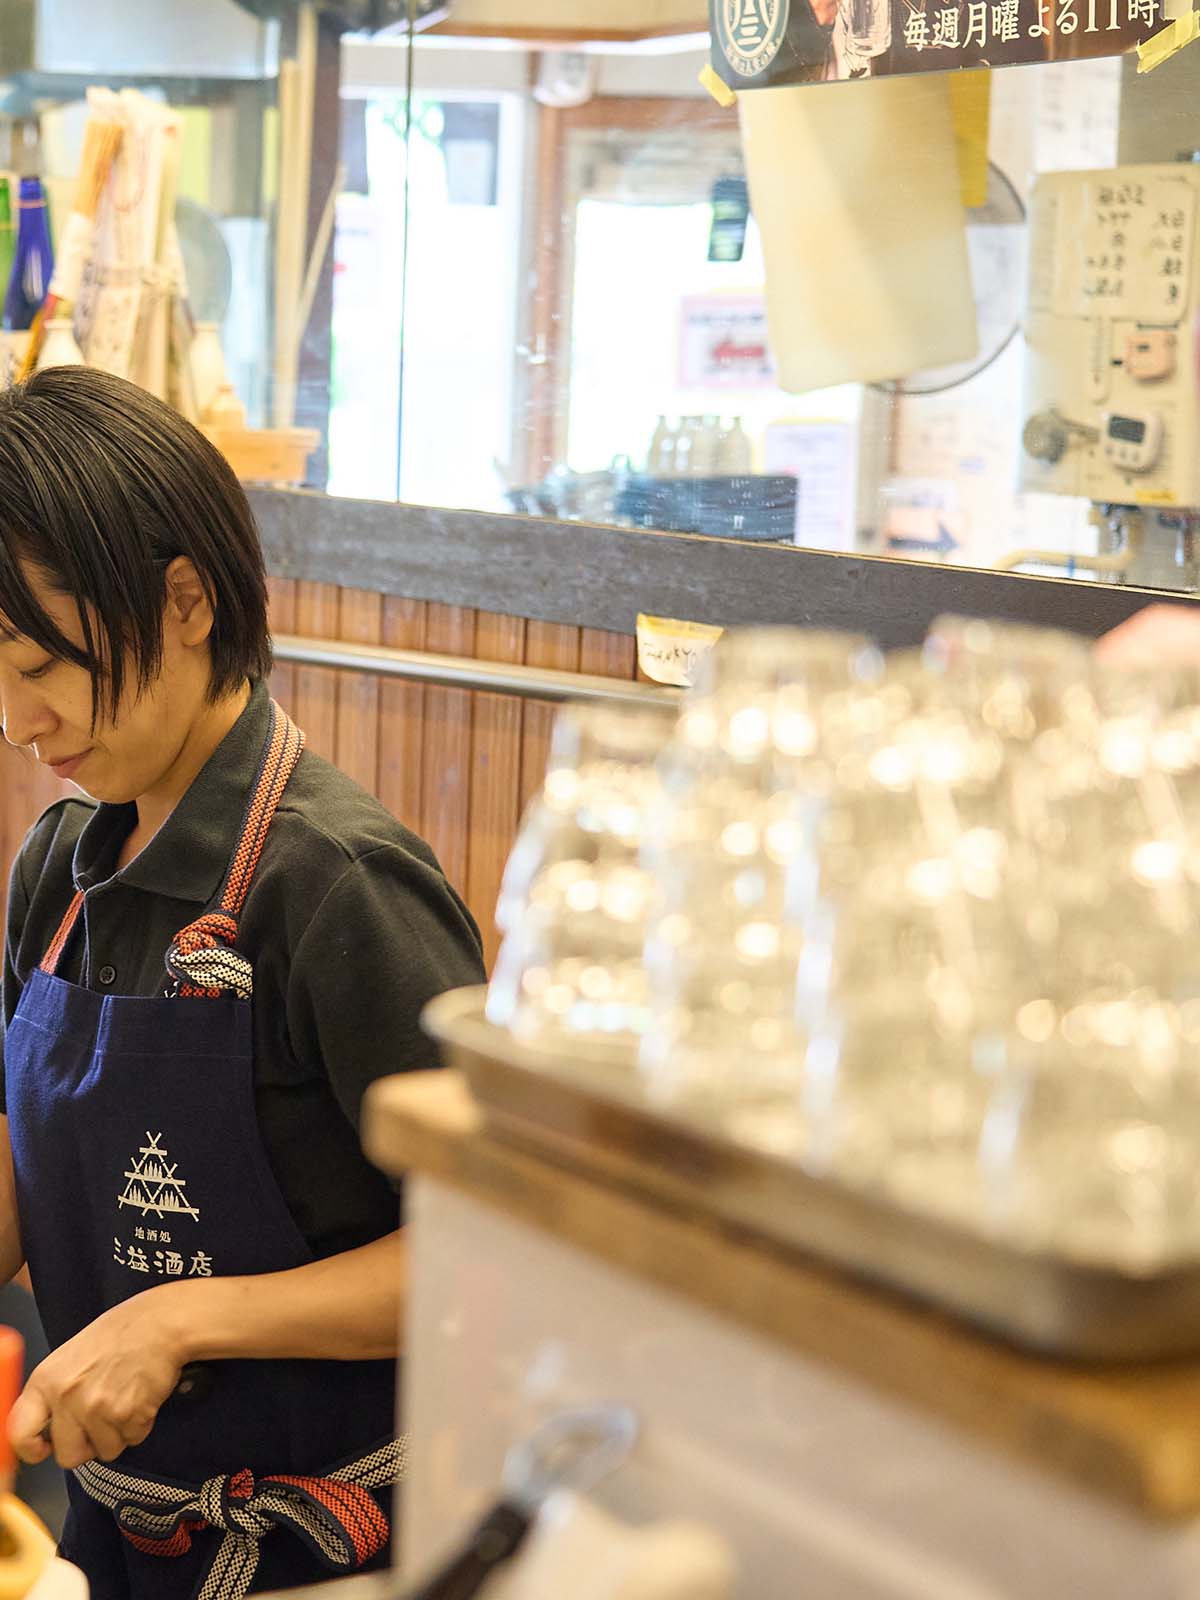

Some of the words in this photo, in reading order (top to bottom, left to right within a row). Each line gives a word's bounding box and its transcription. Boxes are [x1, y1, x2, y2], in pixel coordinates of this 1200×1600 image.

[903, 0, 1159, 51] 毎週月曜よる11時
[134, 1226, 172, 1244] 地酒処
